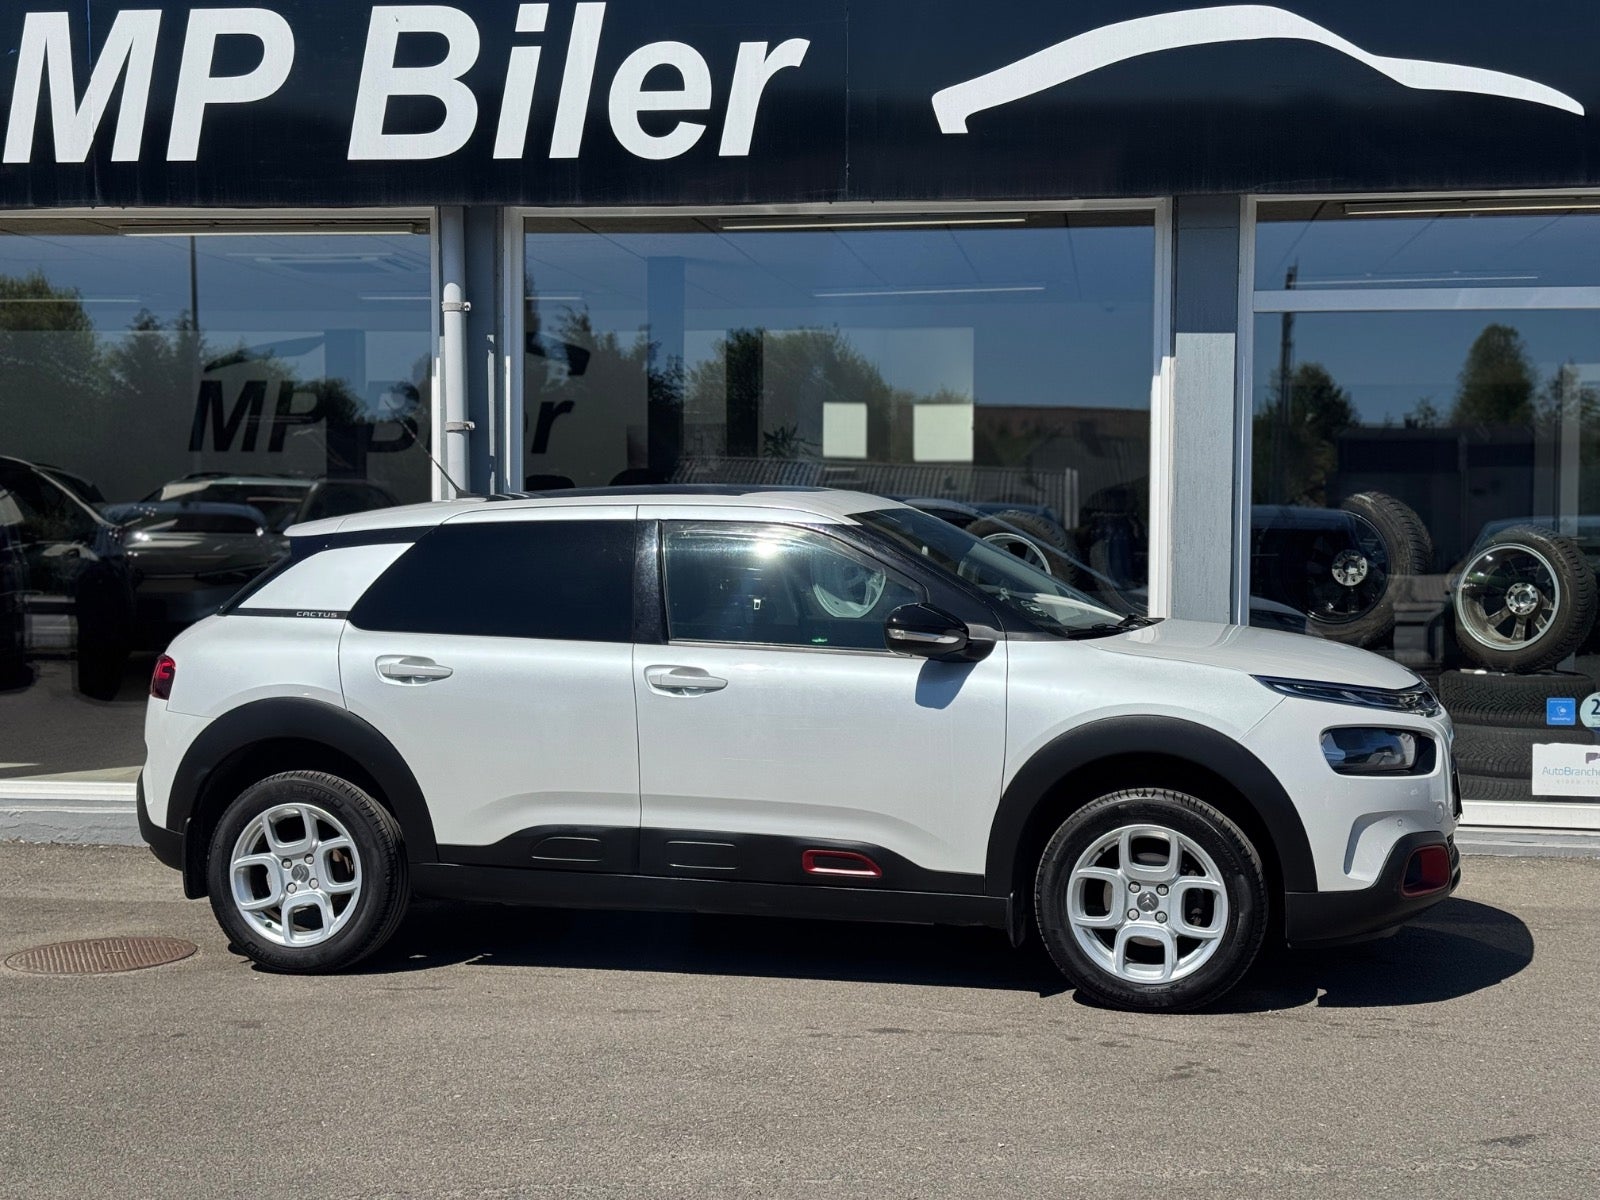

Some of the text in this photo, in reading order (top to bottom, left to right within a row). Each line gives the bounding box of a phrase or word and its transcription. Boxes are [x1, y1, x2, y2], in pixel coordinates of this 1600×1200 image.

[3, 2, 810, 163] MP Biler
[188, 379, 327, 453] MP
